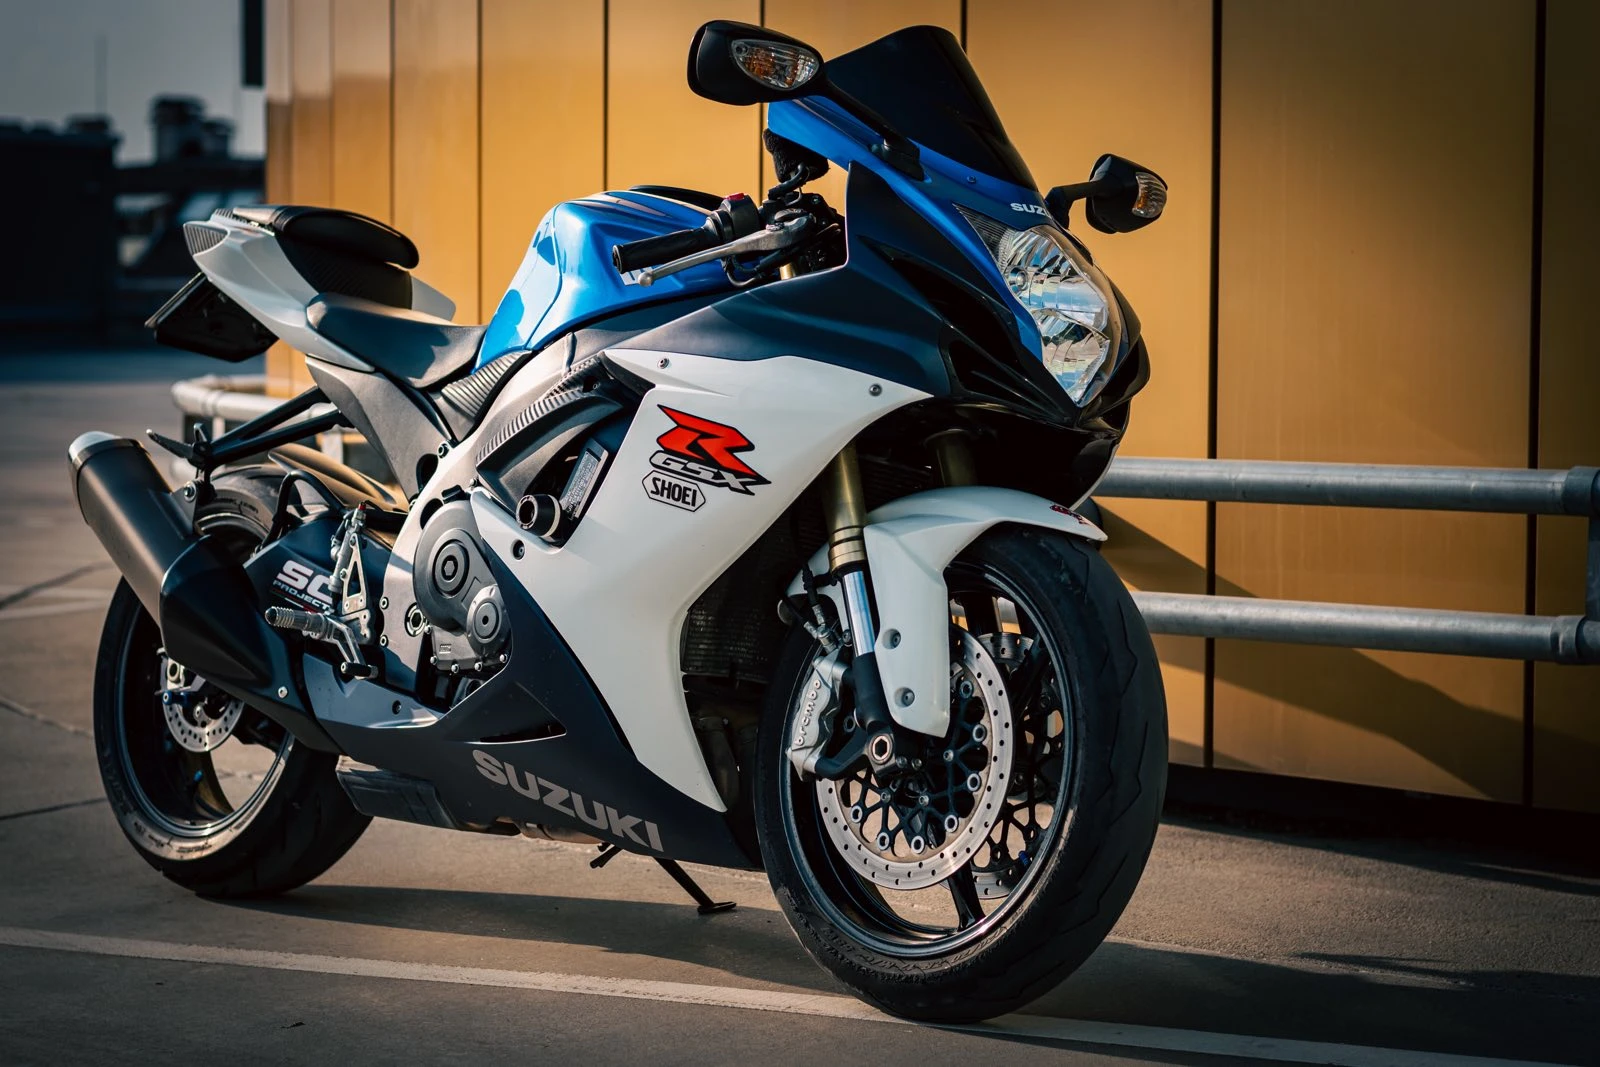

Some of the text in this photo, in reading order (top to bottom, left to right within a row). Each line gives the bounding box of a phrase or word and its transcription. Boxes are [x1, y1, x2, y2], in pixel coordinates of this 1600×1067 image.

[1010, 202, 1052, 219] SUZ
[650, 476, 698, 508] SHOEI
[272, 580, 331, 611] PROJECT
[276, 560, 333, 605] SC
[795, 679, 821, 746] brembo
[472, 749, 664, 853] SUZUKI
